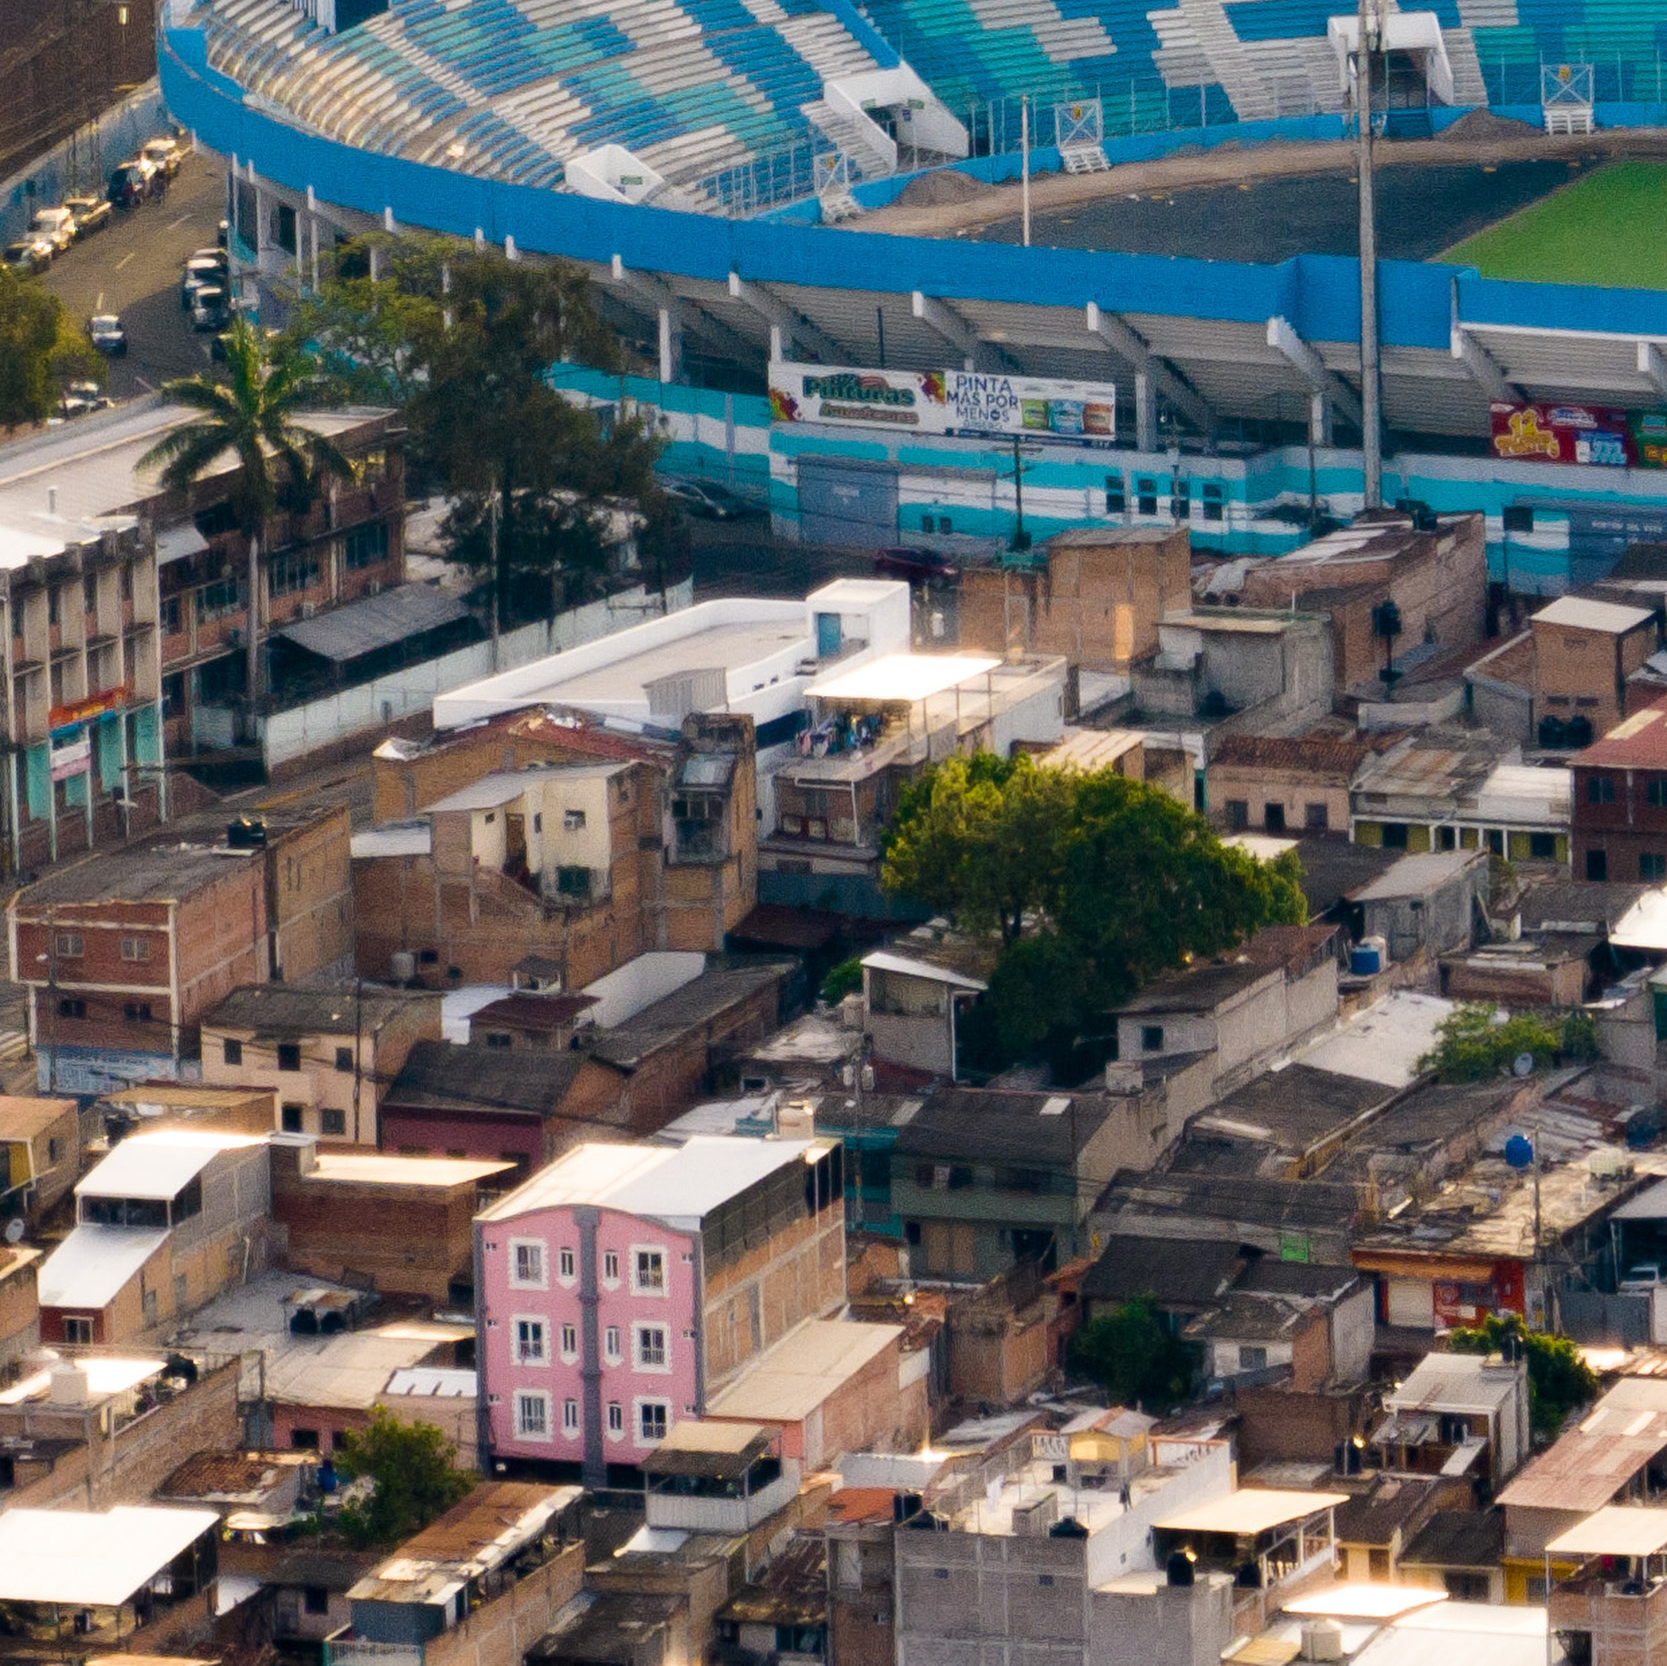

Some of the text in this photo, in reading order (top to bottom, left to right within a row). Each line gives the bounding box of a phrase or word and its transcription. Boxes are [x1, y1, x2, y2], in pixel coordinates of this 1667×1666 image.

[802, 373, 916, 407] Pinturas
[956, 374, 1012, 394] PINTA
[986, 393, 1019, 409] POR
[956, 405, 1010, 422] MENOS
